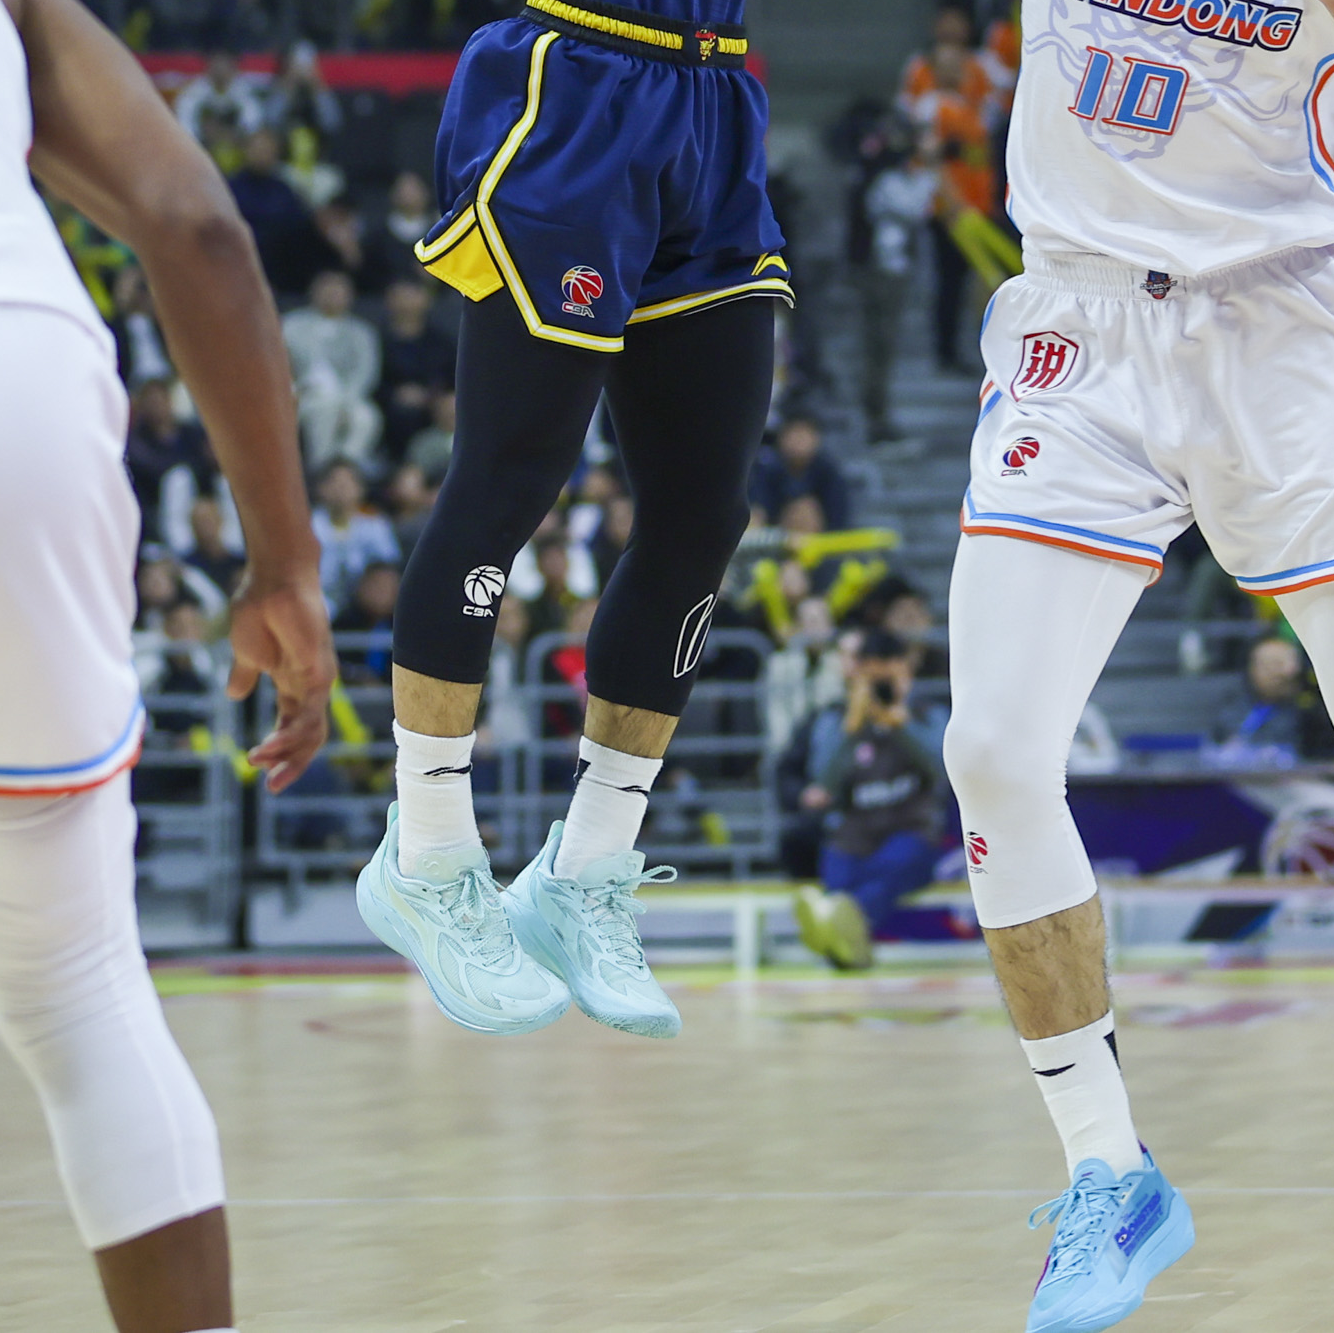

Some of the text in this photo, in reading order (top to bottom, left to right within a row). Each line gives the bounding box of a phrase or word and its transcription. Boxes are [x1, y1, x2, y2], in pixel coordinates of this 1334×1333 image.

[1068, 46, 1190, 136] 10
[562, 302, 595, 318] CBA
[1001, 469, 1028, 477] CBA
[463, 605, 494, 617] CBA
